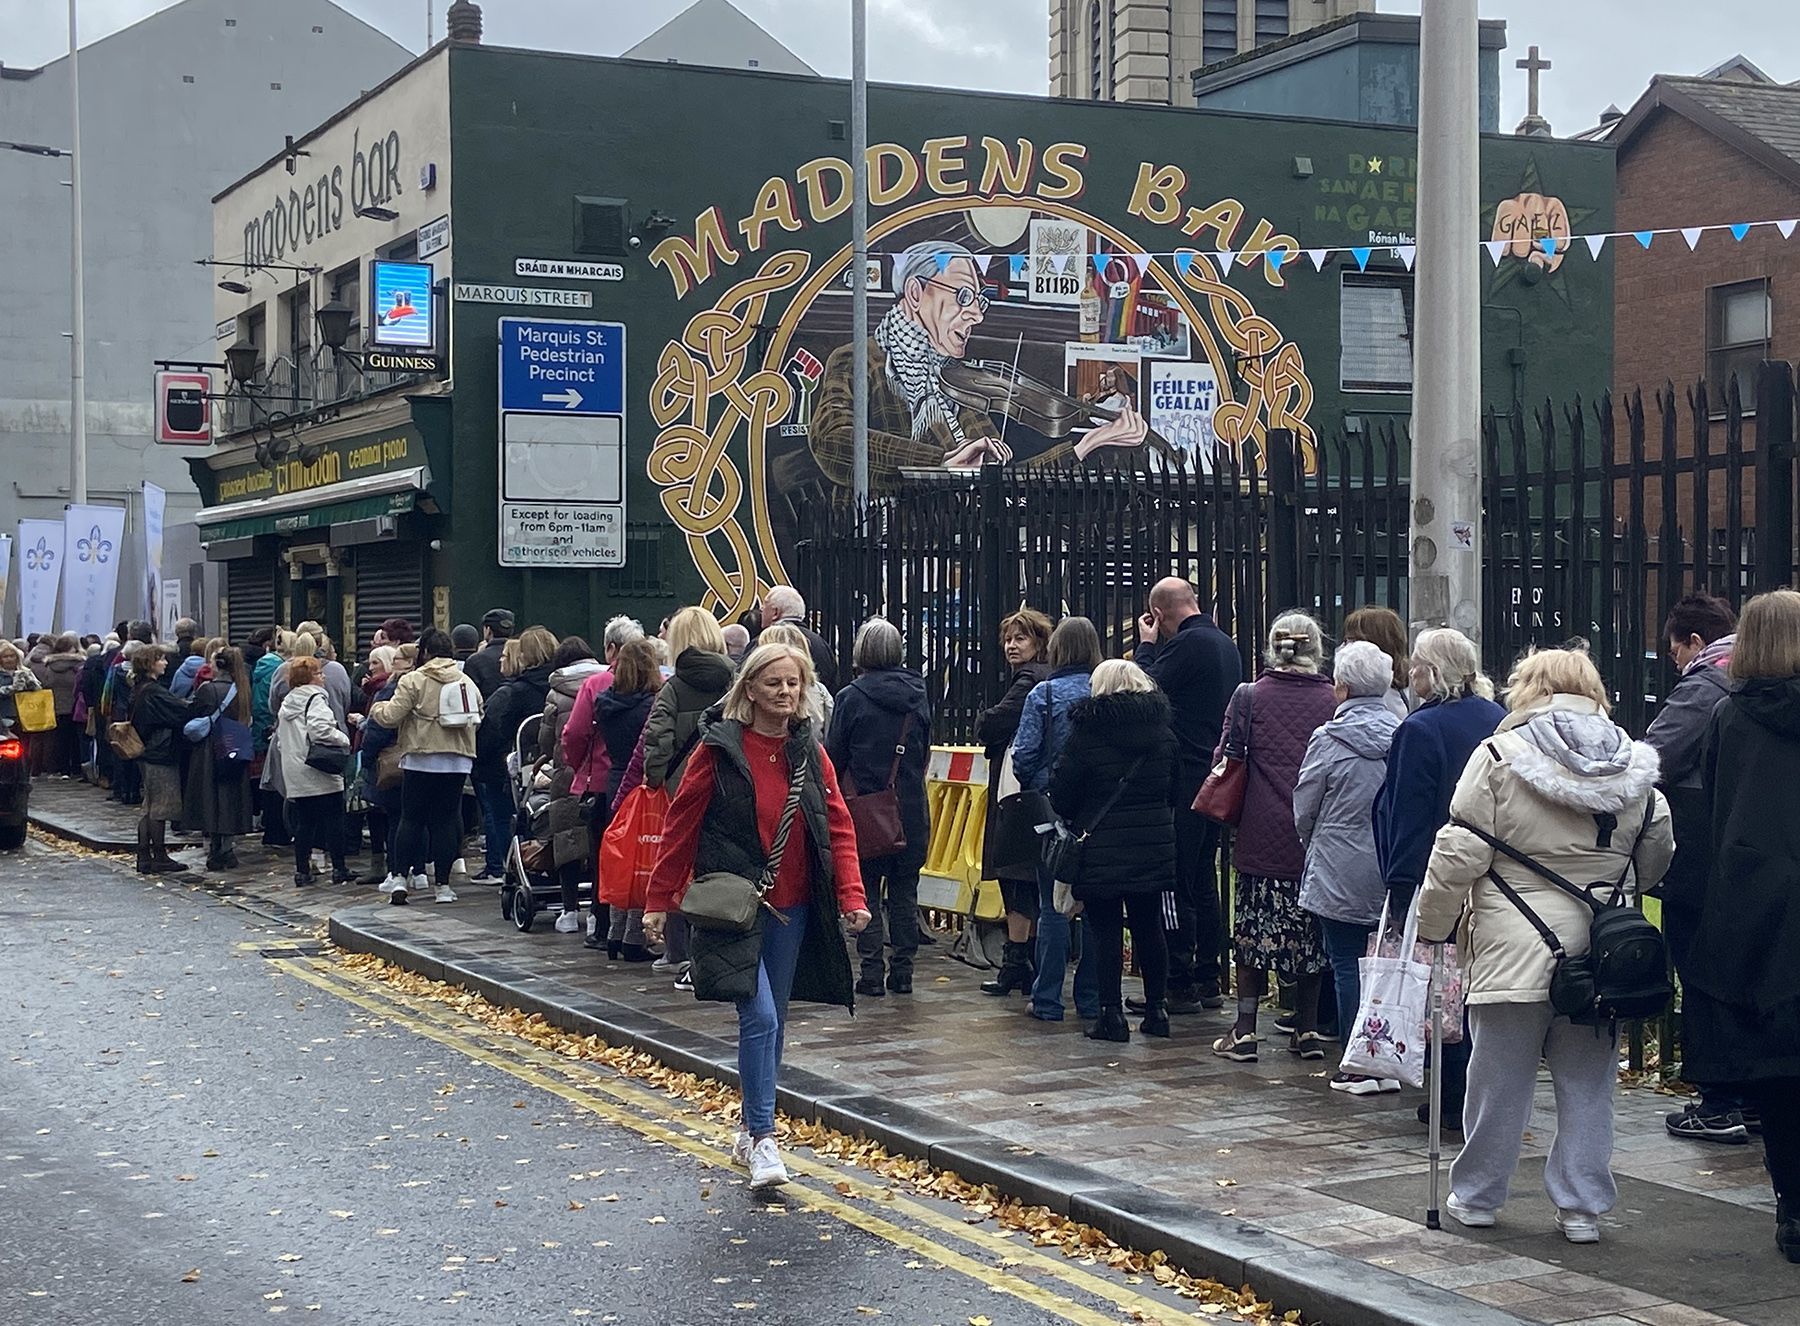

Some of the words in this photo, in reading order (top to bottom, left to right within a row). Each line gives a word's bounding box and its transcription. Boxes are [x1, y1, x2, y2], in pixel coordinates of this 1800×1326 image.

[1320, 178, 1358, 194] SAN
[649, 136, 1088, 299] MADDENS
[1127, 162, 1300, 288] BAR
[1315, 205, 1341, 222] NA
[1346, 204, 1415, 231] GAE
[1499, 212, 1562, 233] GAEL
[1369, 230, 1398, 244] Rónán
[518, 259, 548, 273] SRÁID
[550, 264, 564, 275] AN
[566, 264, 622, 279] MHARCAIS
[1035, 276, 1080, 296] BIIRD
[457, 286, 528, 304] MARQUIS
[534, 291, 590, 306] STREET
[518, 326, 581, 347] Marquis
[586, 331, 608, 346] St.
[369, 353, 436, 370] GUINNESS
[520, 346, 605, 365] Pedestrian
[529, 365, 595, 382] Precinct
[1153, 372, 1197, 395] FÉILE
[1197, 380, 1215, 392] NA
[1155, 392, 1210, 411] GEALAÍ
[782, 425, 811, 435] RESIST
[512, 508, 549, 523] Except
[553, 509, 569, 520] for
[573, 510, 614, 523] loading
[520, 522, 546, 532] from
[552, 535, 574, 545] and
[572, 547, 617, 558] vehicles
